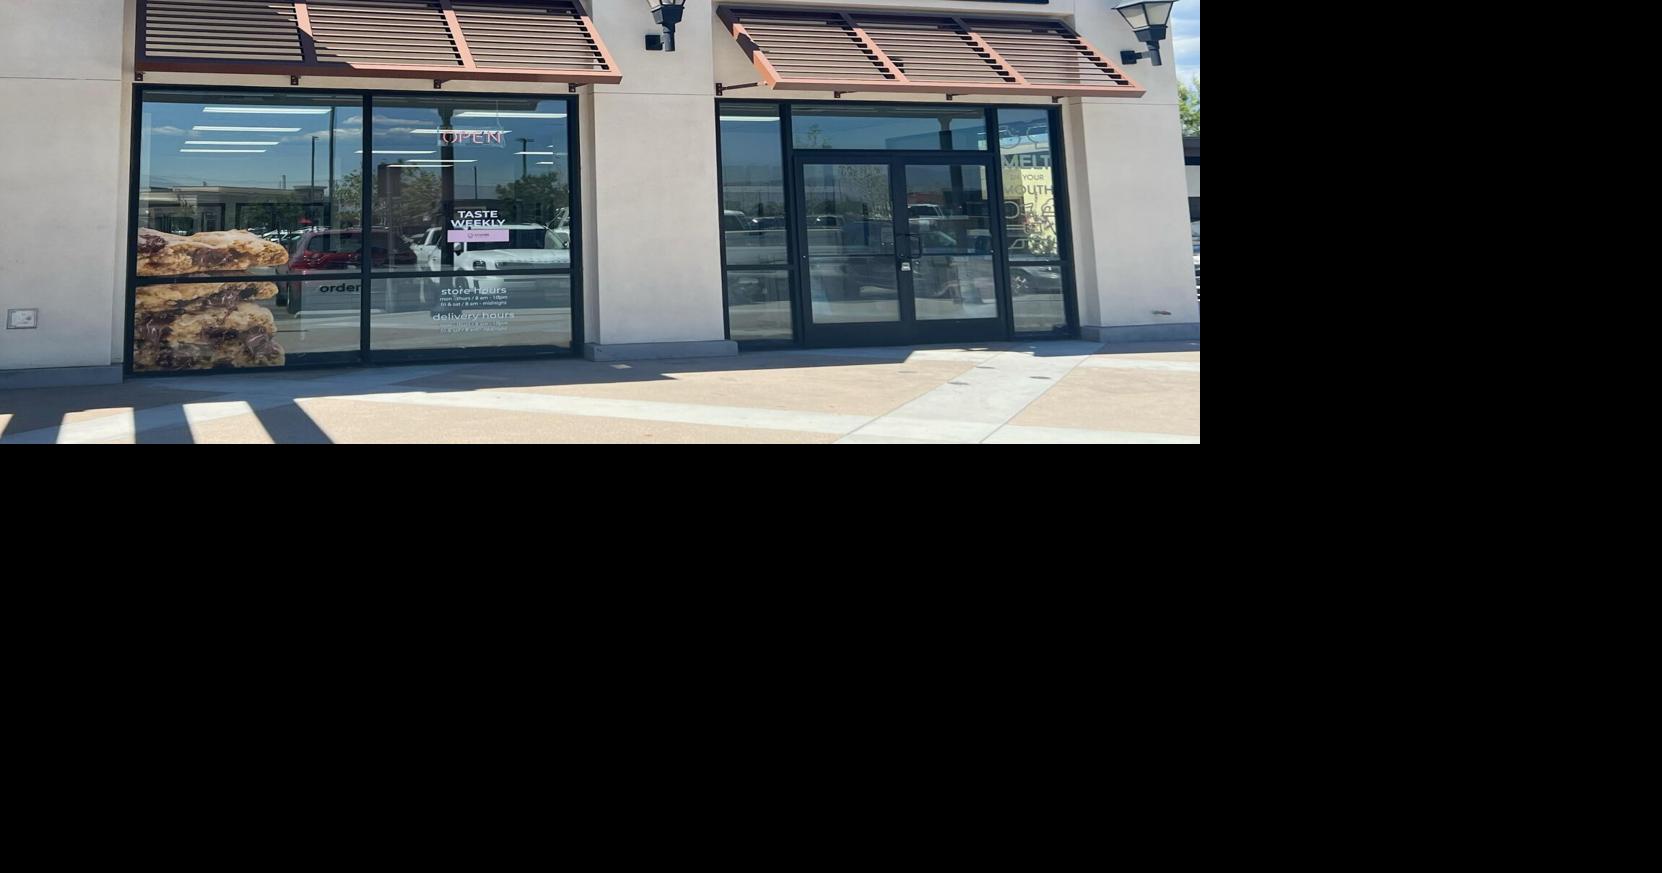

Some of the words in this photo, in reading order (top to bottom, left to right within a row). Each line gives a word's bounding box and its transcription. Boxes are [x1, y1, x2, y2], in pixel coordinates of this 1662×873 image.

[442, 130, 501, 144] OPEN
[1001, 152, 1050, 169] MELT
[1004, 184, 1055, 196] MOUTH
[457, 210, 499, 219] TASTE
[450, 219, 506, 228] WEEKLY
[319, 282, 361, 293] order
[441, 285, 471, 296] store
[474, 286, 507, 295] hours
[432, 312, 479, 321] delivery
[482, 311, 515, 319] hours
